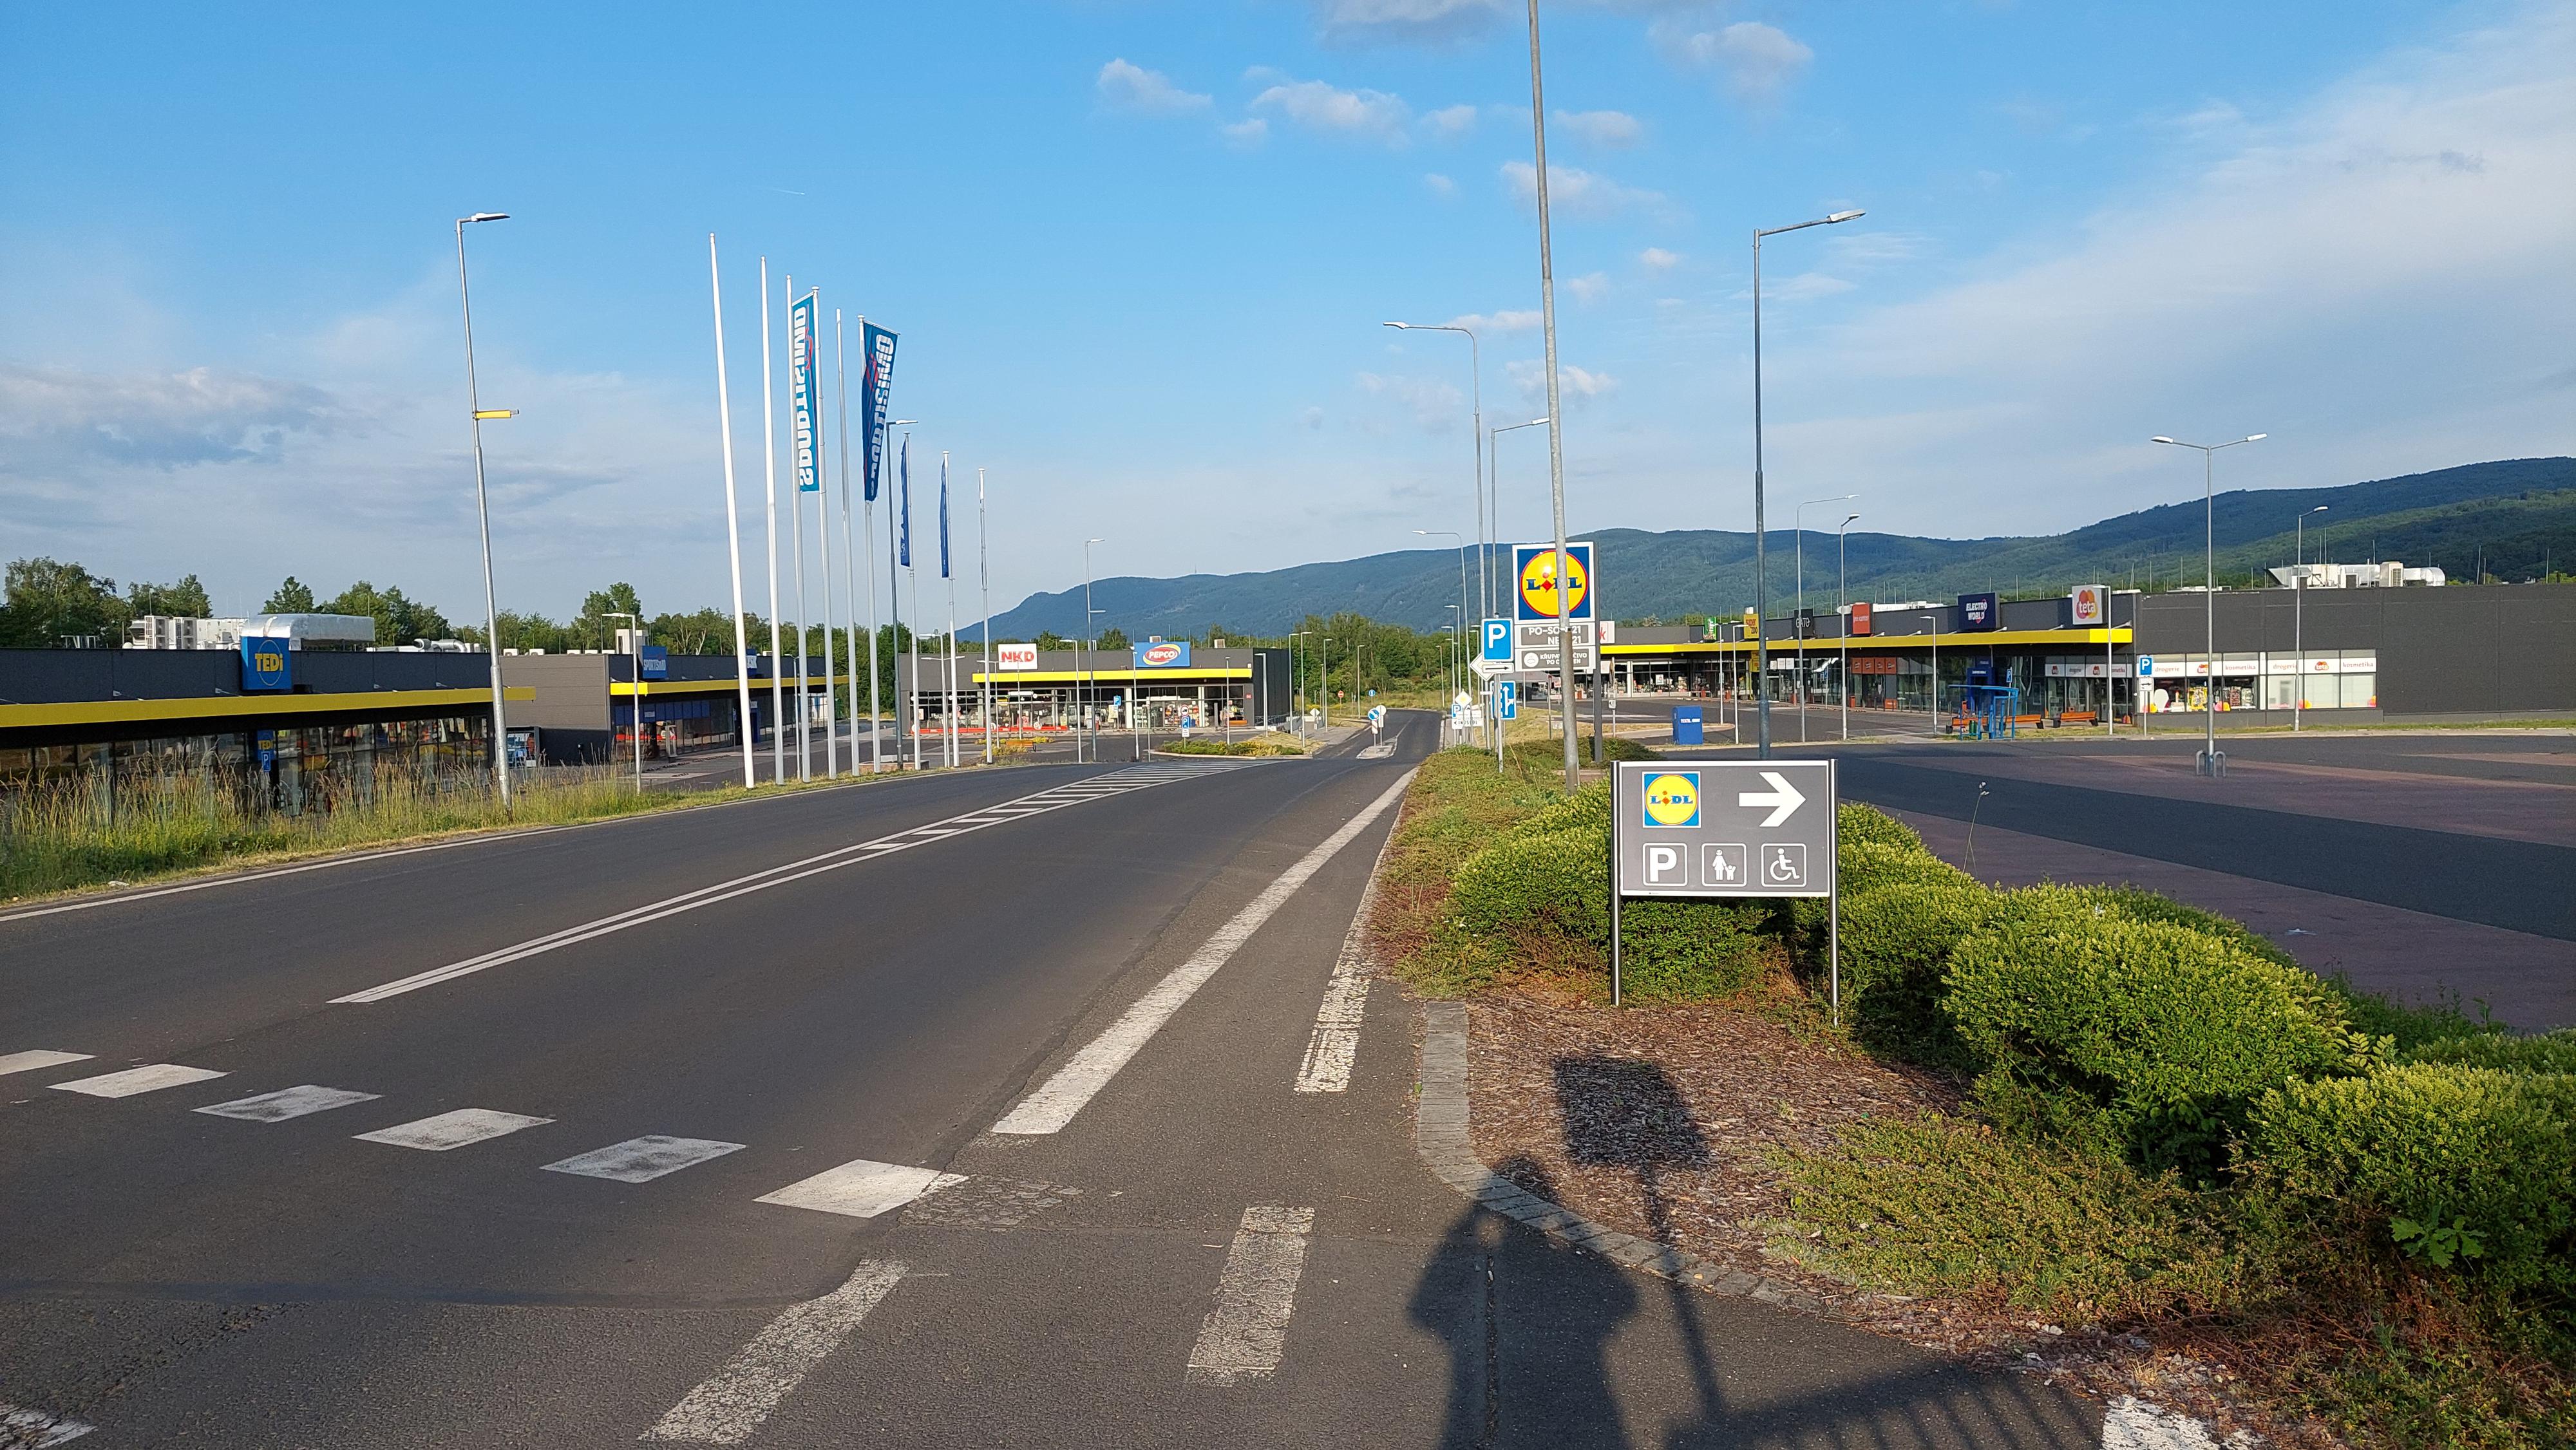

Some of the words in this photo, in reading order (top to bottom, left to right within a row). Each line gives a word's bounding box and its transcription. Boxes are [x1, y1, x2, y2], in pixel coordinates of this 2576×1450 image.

[1965, 601, 1988, 612] ELECTRO
[2079, 600, 2096, 614] teta
[1967, 611, 1985, 620] WORLD
[1488, 623, 1506, 649] P
[1001, 650, 1035, 663] NKD
[1148, 650, 1176, 659] PEPCO
[2141, 659, 2150, 670] P
[263, 754, 269, 766] P
[1649, 847, 1678, 882] P
